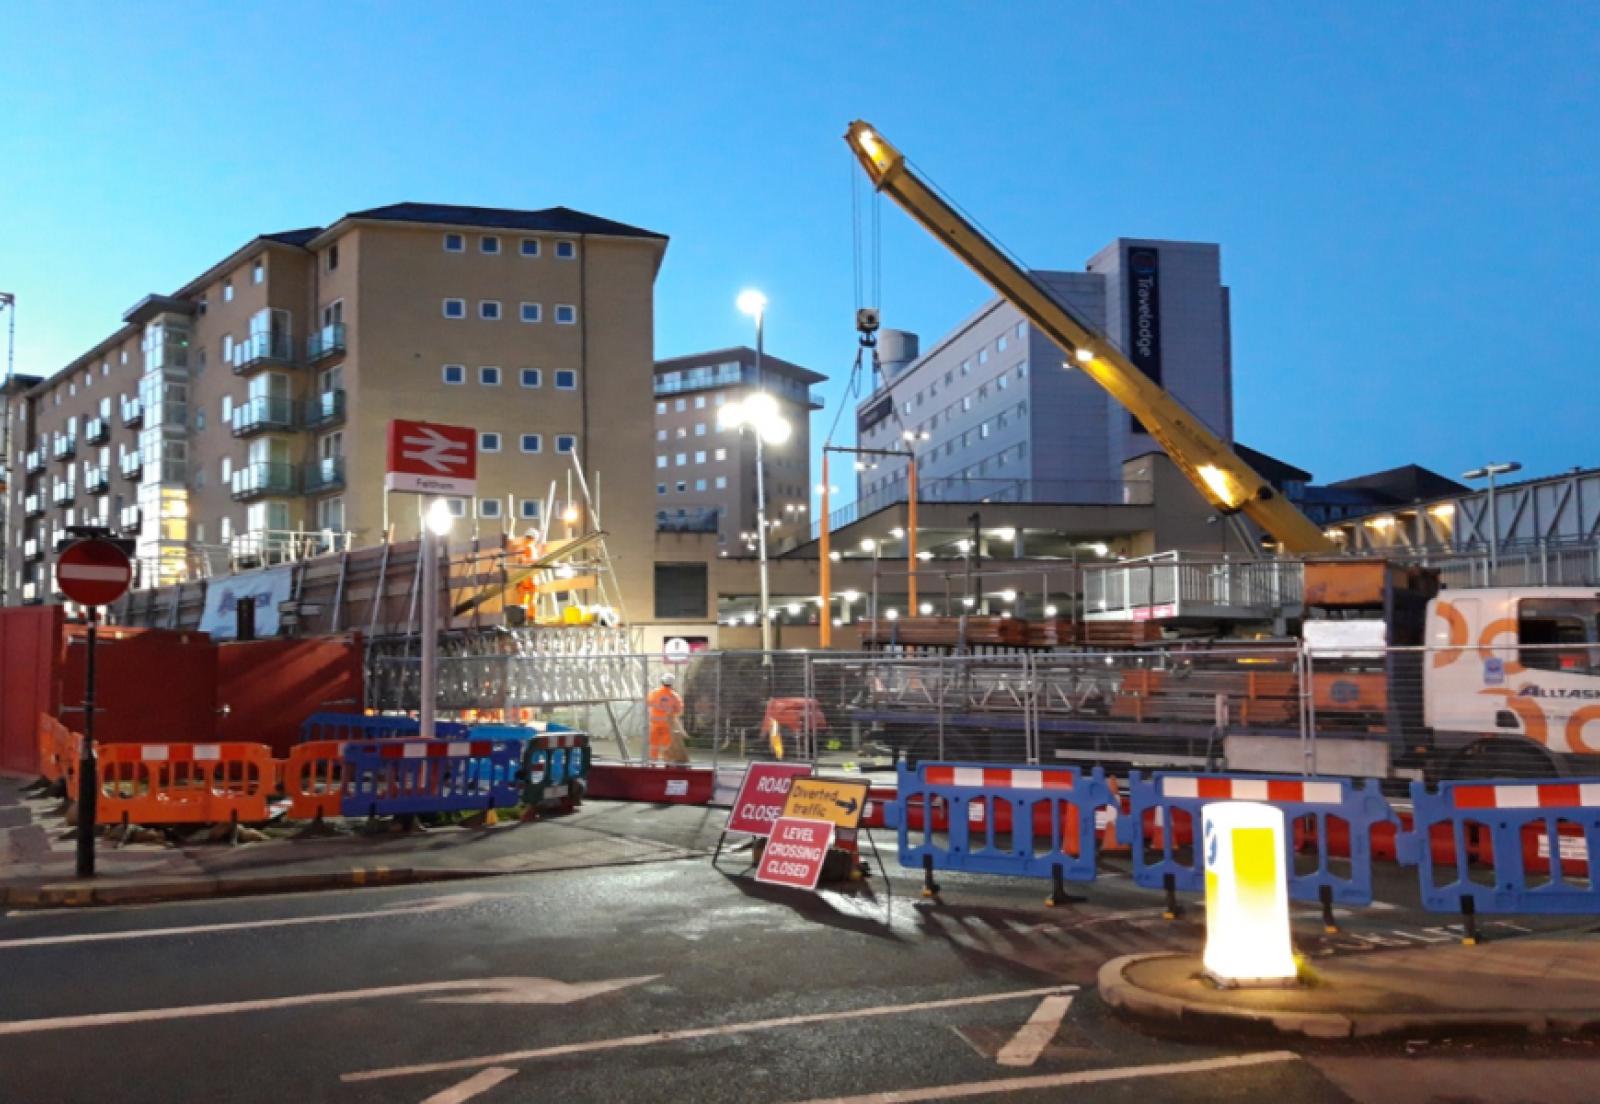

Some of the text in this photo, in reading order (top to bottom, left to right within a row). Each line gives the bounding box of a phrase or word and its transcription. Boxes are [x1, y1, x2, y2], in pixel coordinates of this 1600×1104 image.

[1136, 276, 1154, 358] Travelodge
[757, 775, 791, 794] ROAD
[793, 785, 839, 801] Diverted
[741, 803, 782, 822] CLOSE
[793, 803, 827, 817] traffic
[782, 826, 814, 842] LEVEL
[768, 842, 821, 861] CROSSING
[766, 860, 810, 878] CLOSED
